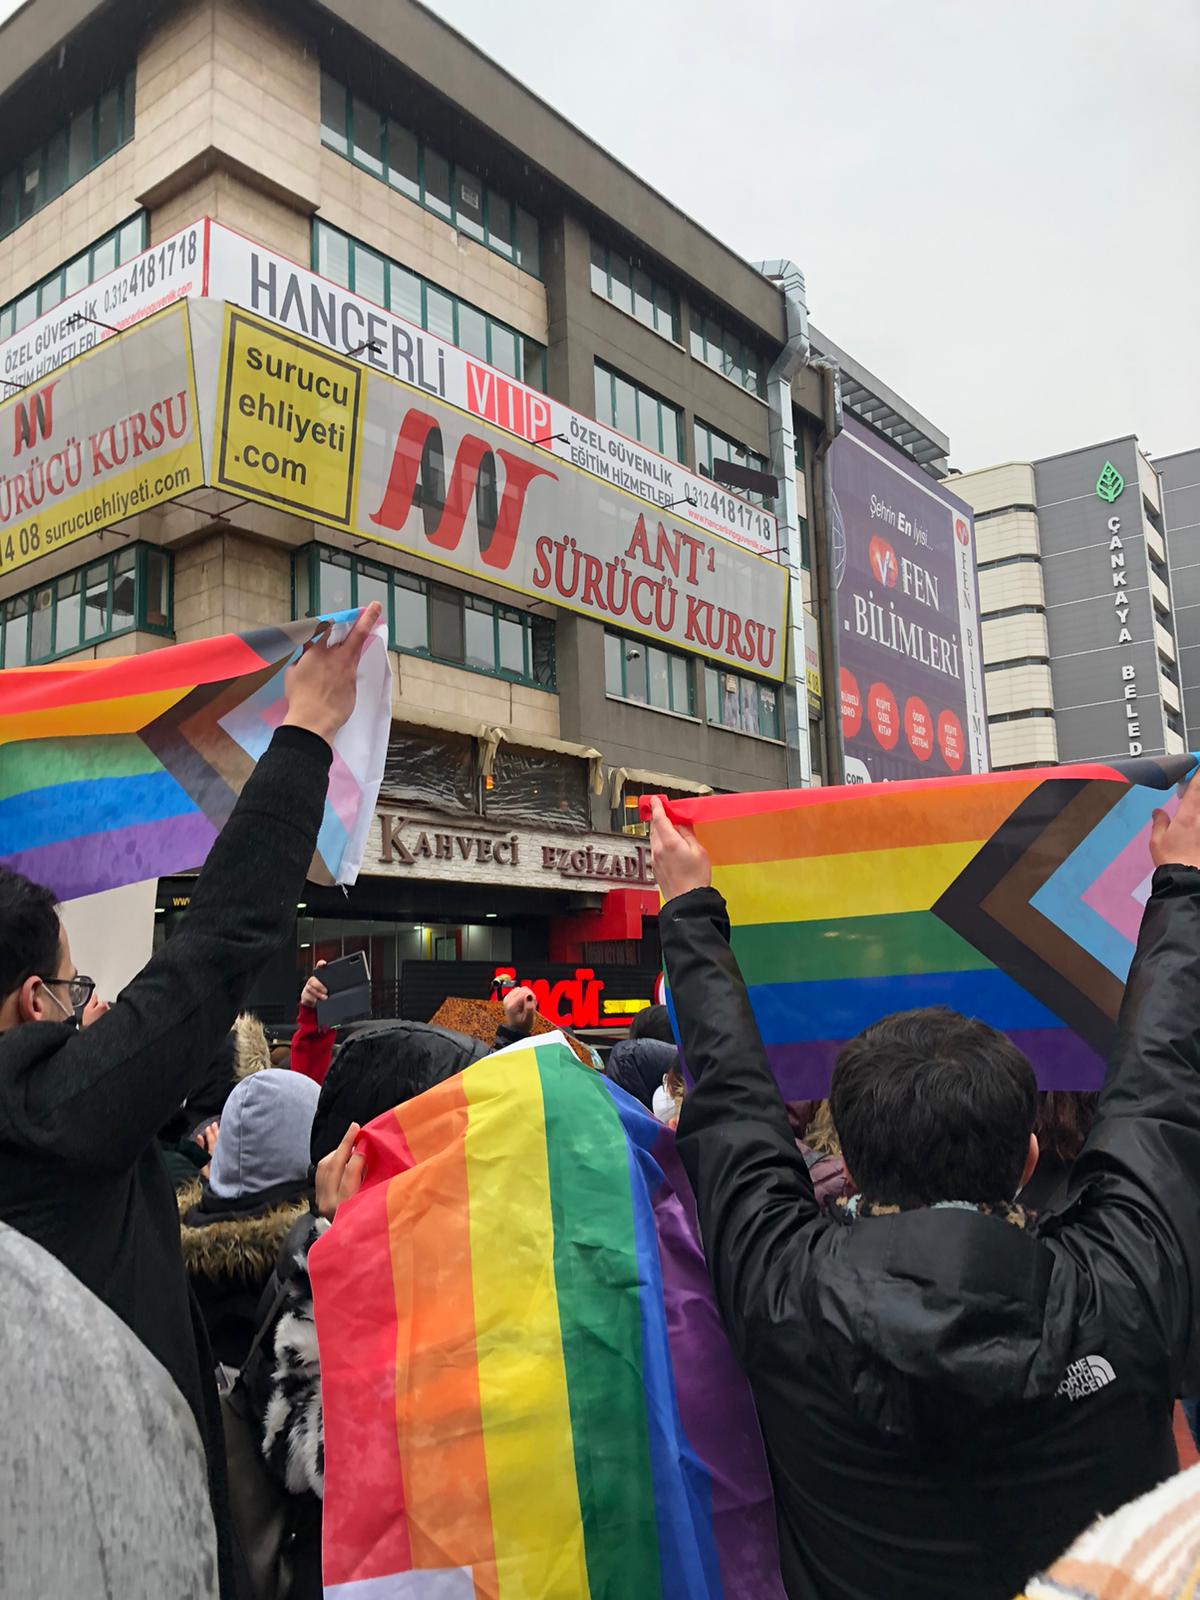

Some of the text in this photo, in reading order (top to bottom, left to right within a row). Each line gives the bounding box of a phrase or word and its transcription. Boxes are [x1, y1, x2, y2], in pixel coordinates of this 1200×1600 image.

[4, 342, 33, 374] ÖZEL
[35, 299, 98, 355] GÜVENLİK
[246, 346, 349, 407] surucu
[470, 365, 547, 441] VIP
[90, 390, 187, 477] KURSU
[239, 392, 345, 453] ehliyeti
[570, 416, 606, 454] ÖZEL
[608, 440, 673, 488] GÜVENLİK
[234, 444, 307, 485] .com
[570, 445, 675, 511] EĞİTİM HİZMETLERİ
[20, 523, 40, 556] 08
[46, 466, 190, 545] surucuehliyeti.com
[870, 494, 896, 528] Şehrin
[897, 511, 912, 537] En
[533, 534, 776, 668] SÜRÜCÜ KURSU
[901, 556, 939, 611] FEN
[1107, 516, 1133, 644] ÇANKAYA
[1121, 664, 1143, 758] BELED
[378, 813, 520, 866] KAHVECİ
[1066, 1358, 1088, 1378] THE
[1067, 1380, 1099, 1402] FACE
